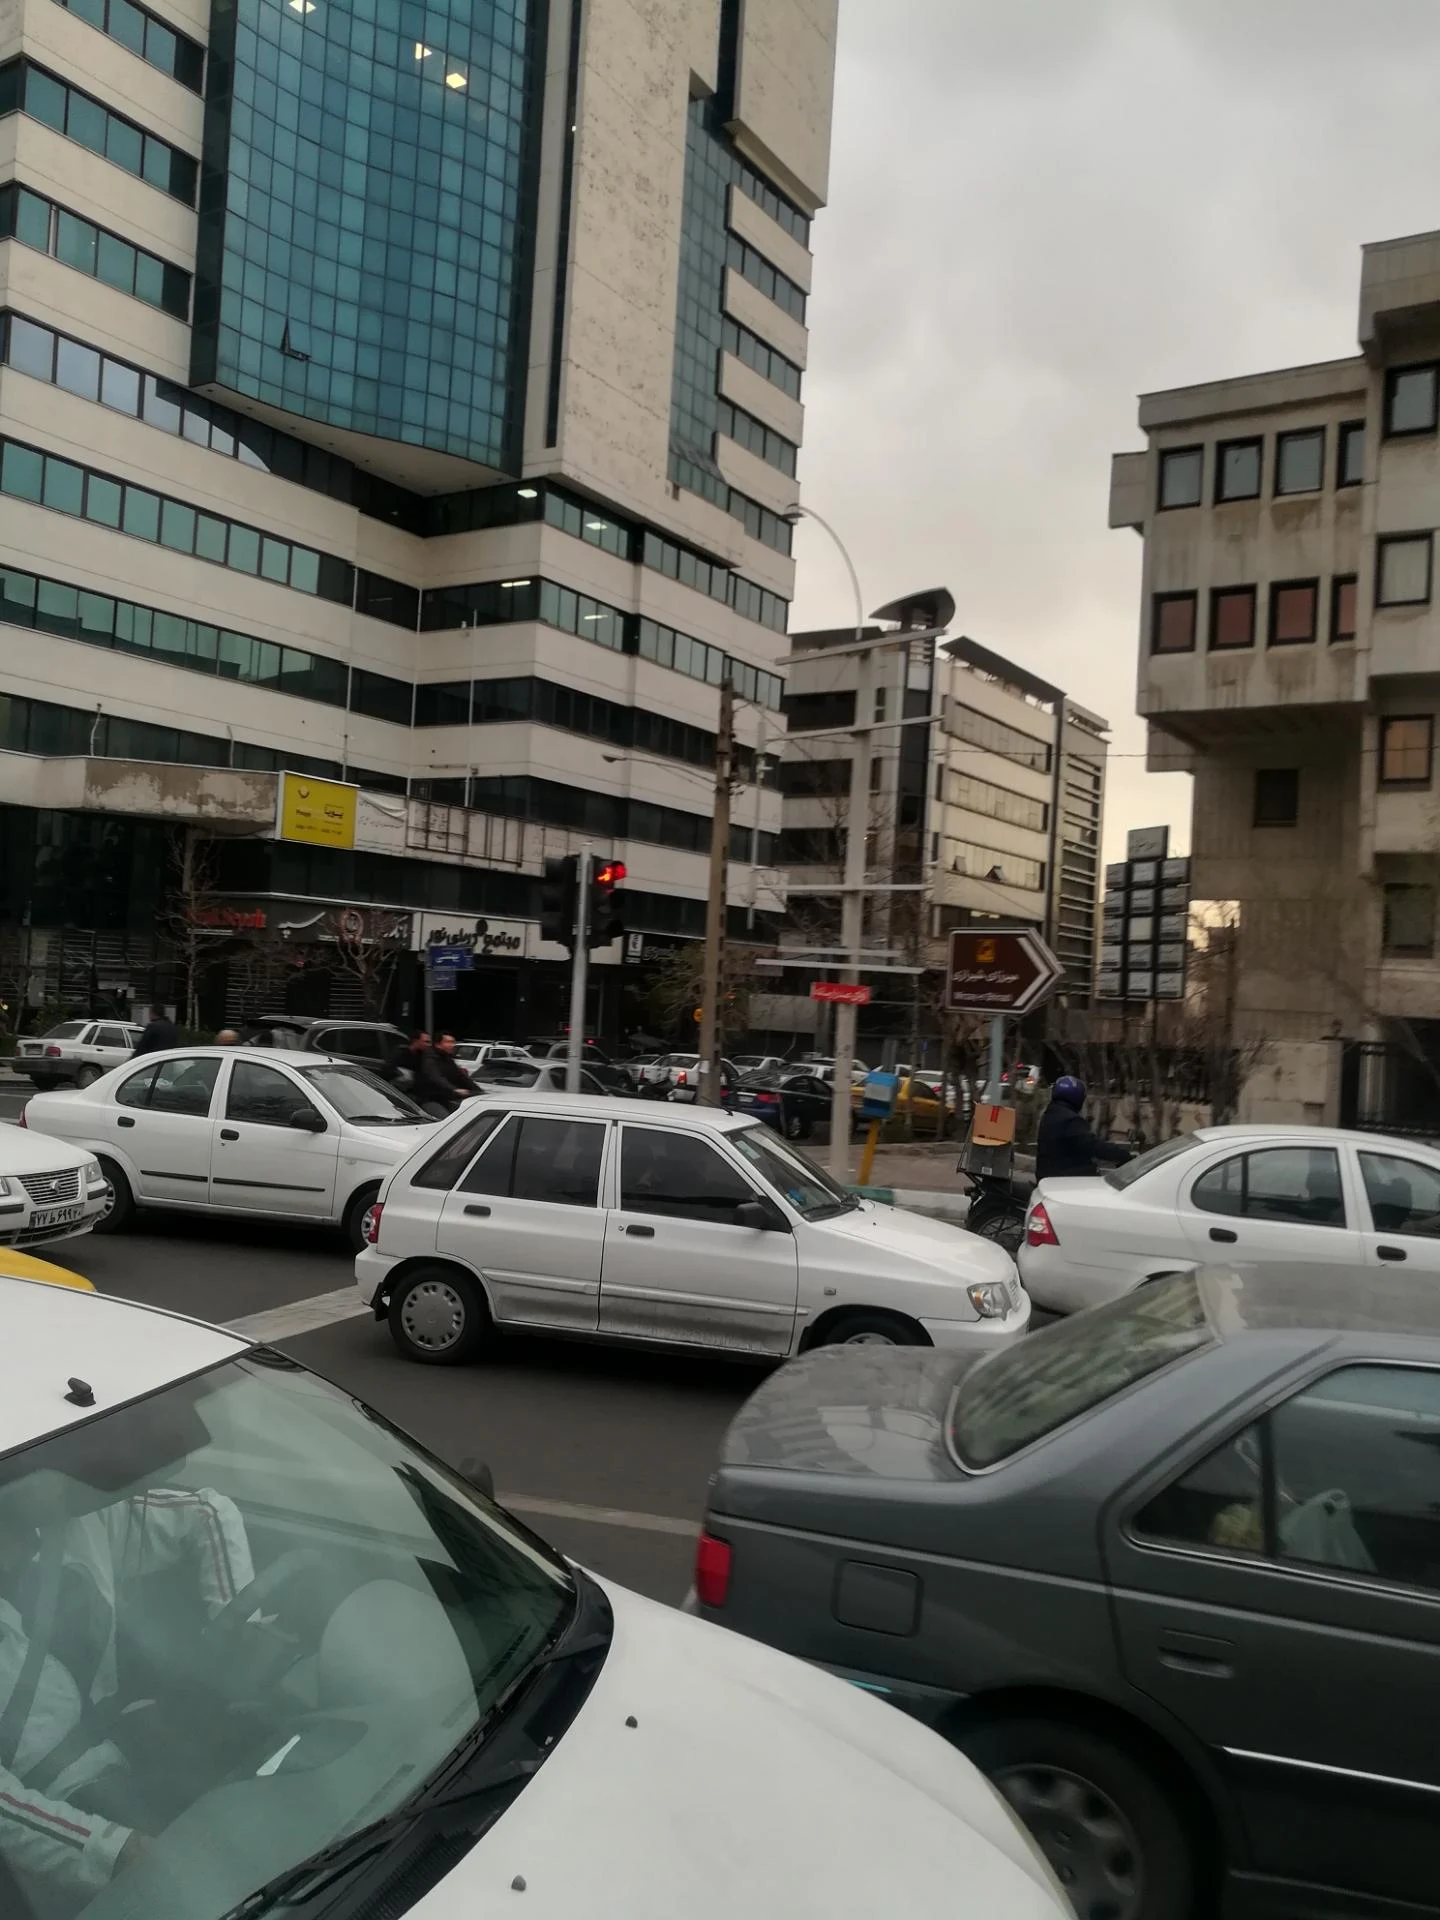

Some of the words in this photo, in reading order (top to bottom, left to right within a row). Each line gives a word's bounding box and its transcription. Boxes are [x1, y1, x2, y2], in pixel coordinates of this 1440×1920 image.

[481, 931, 521, 955] مجتمع
[953, 968, 986, 983] شیرازی
[985, 969, 1020, 984] میرزای
